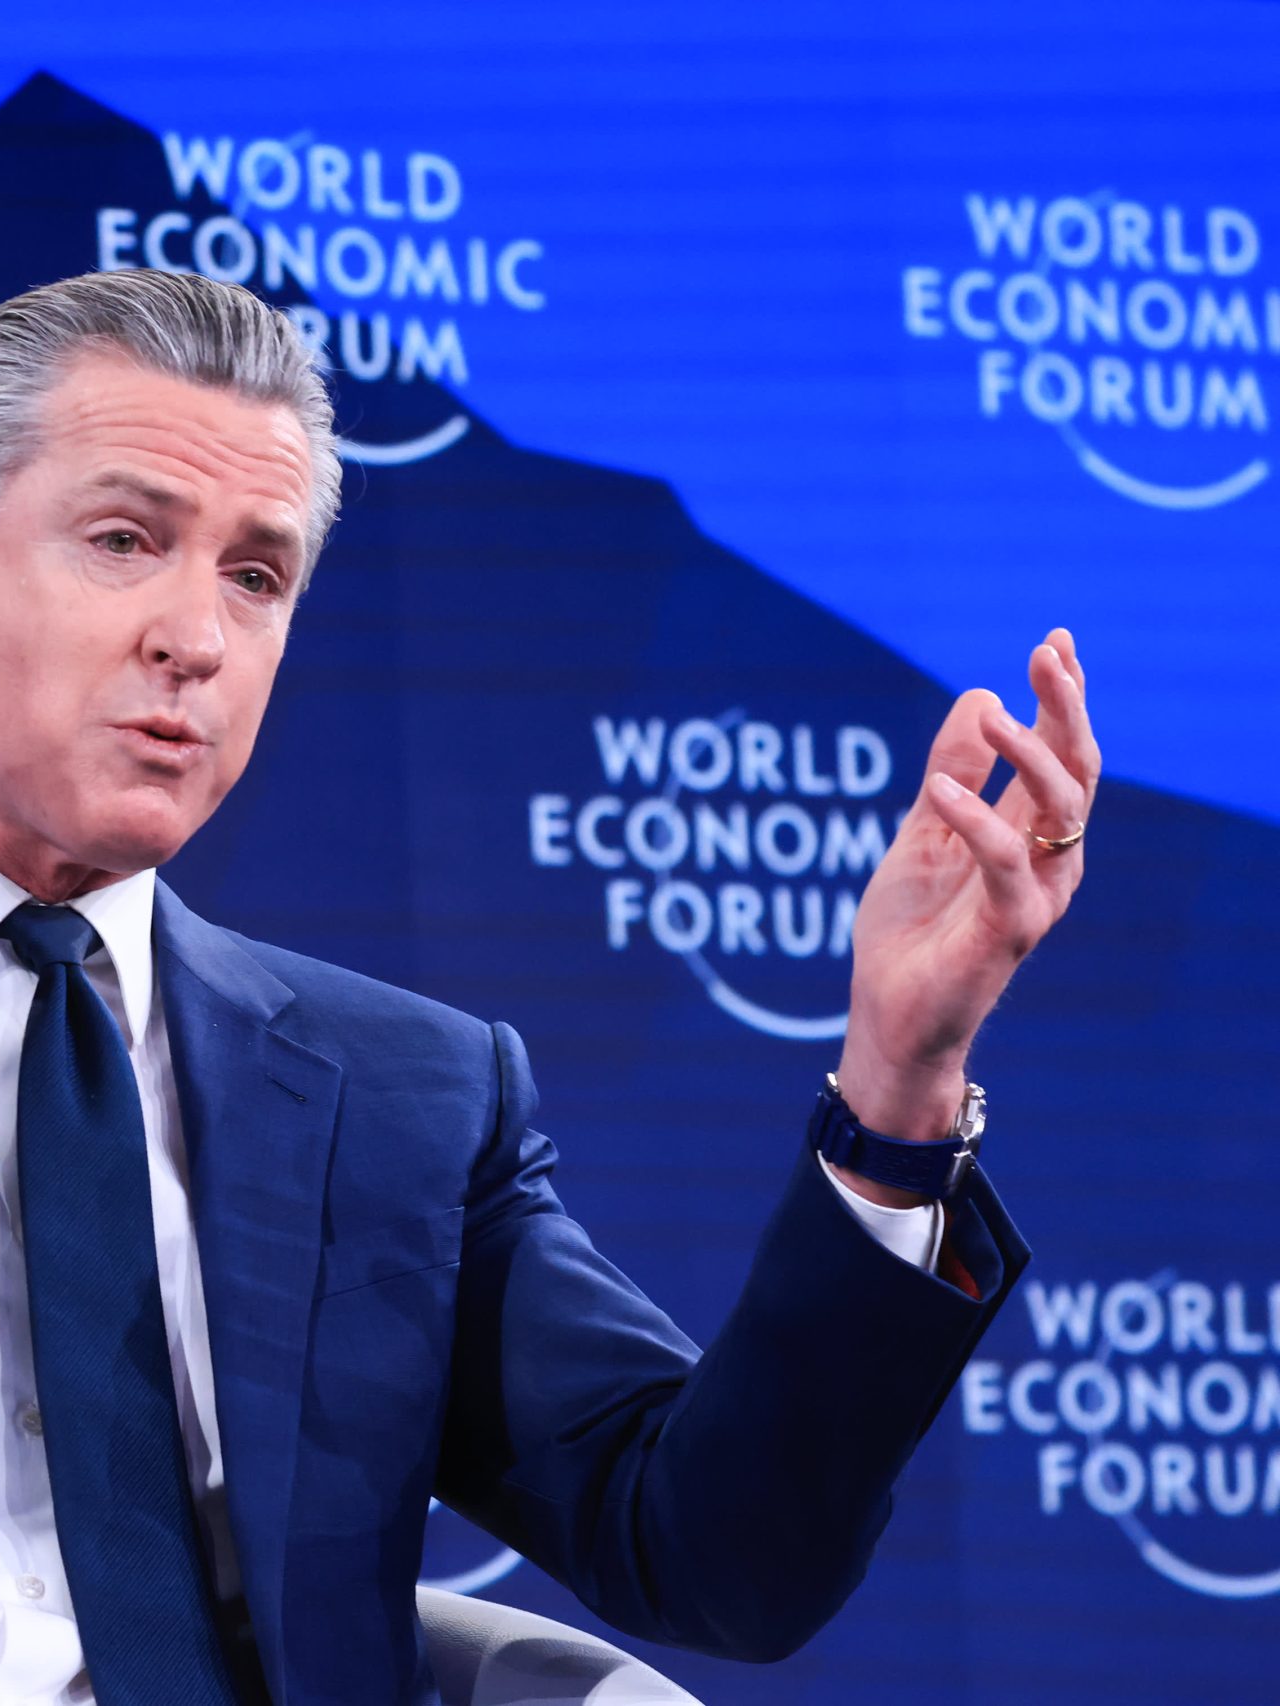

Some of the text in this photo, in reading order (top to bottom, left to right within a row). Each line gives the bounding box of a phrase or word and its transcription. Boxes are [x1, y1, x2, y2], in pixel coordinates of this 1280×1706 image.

[162, 132, 462, 222] WORLD
[97, 207, 547, 310] ECONOMIC
[966, 193, 1261, 277] WORLD
[286, 303, 470, 385] RUM
[902, 266, 1280, 356] ECONOMI
[978, 349, 1270, 434] FORUM
[593, 715, 892, 798] WORLD
[529, 794, 910, 877] ECONOM
[1025, 1279, 1280, 1355] WORL
[961, 1360, 1280, 1435] ECONO
